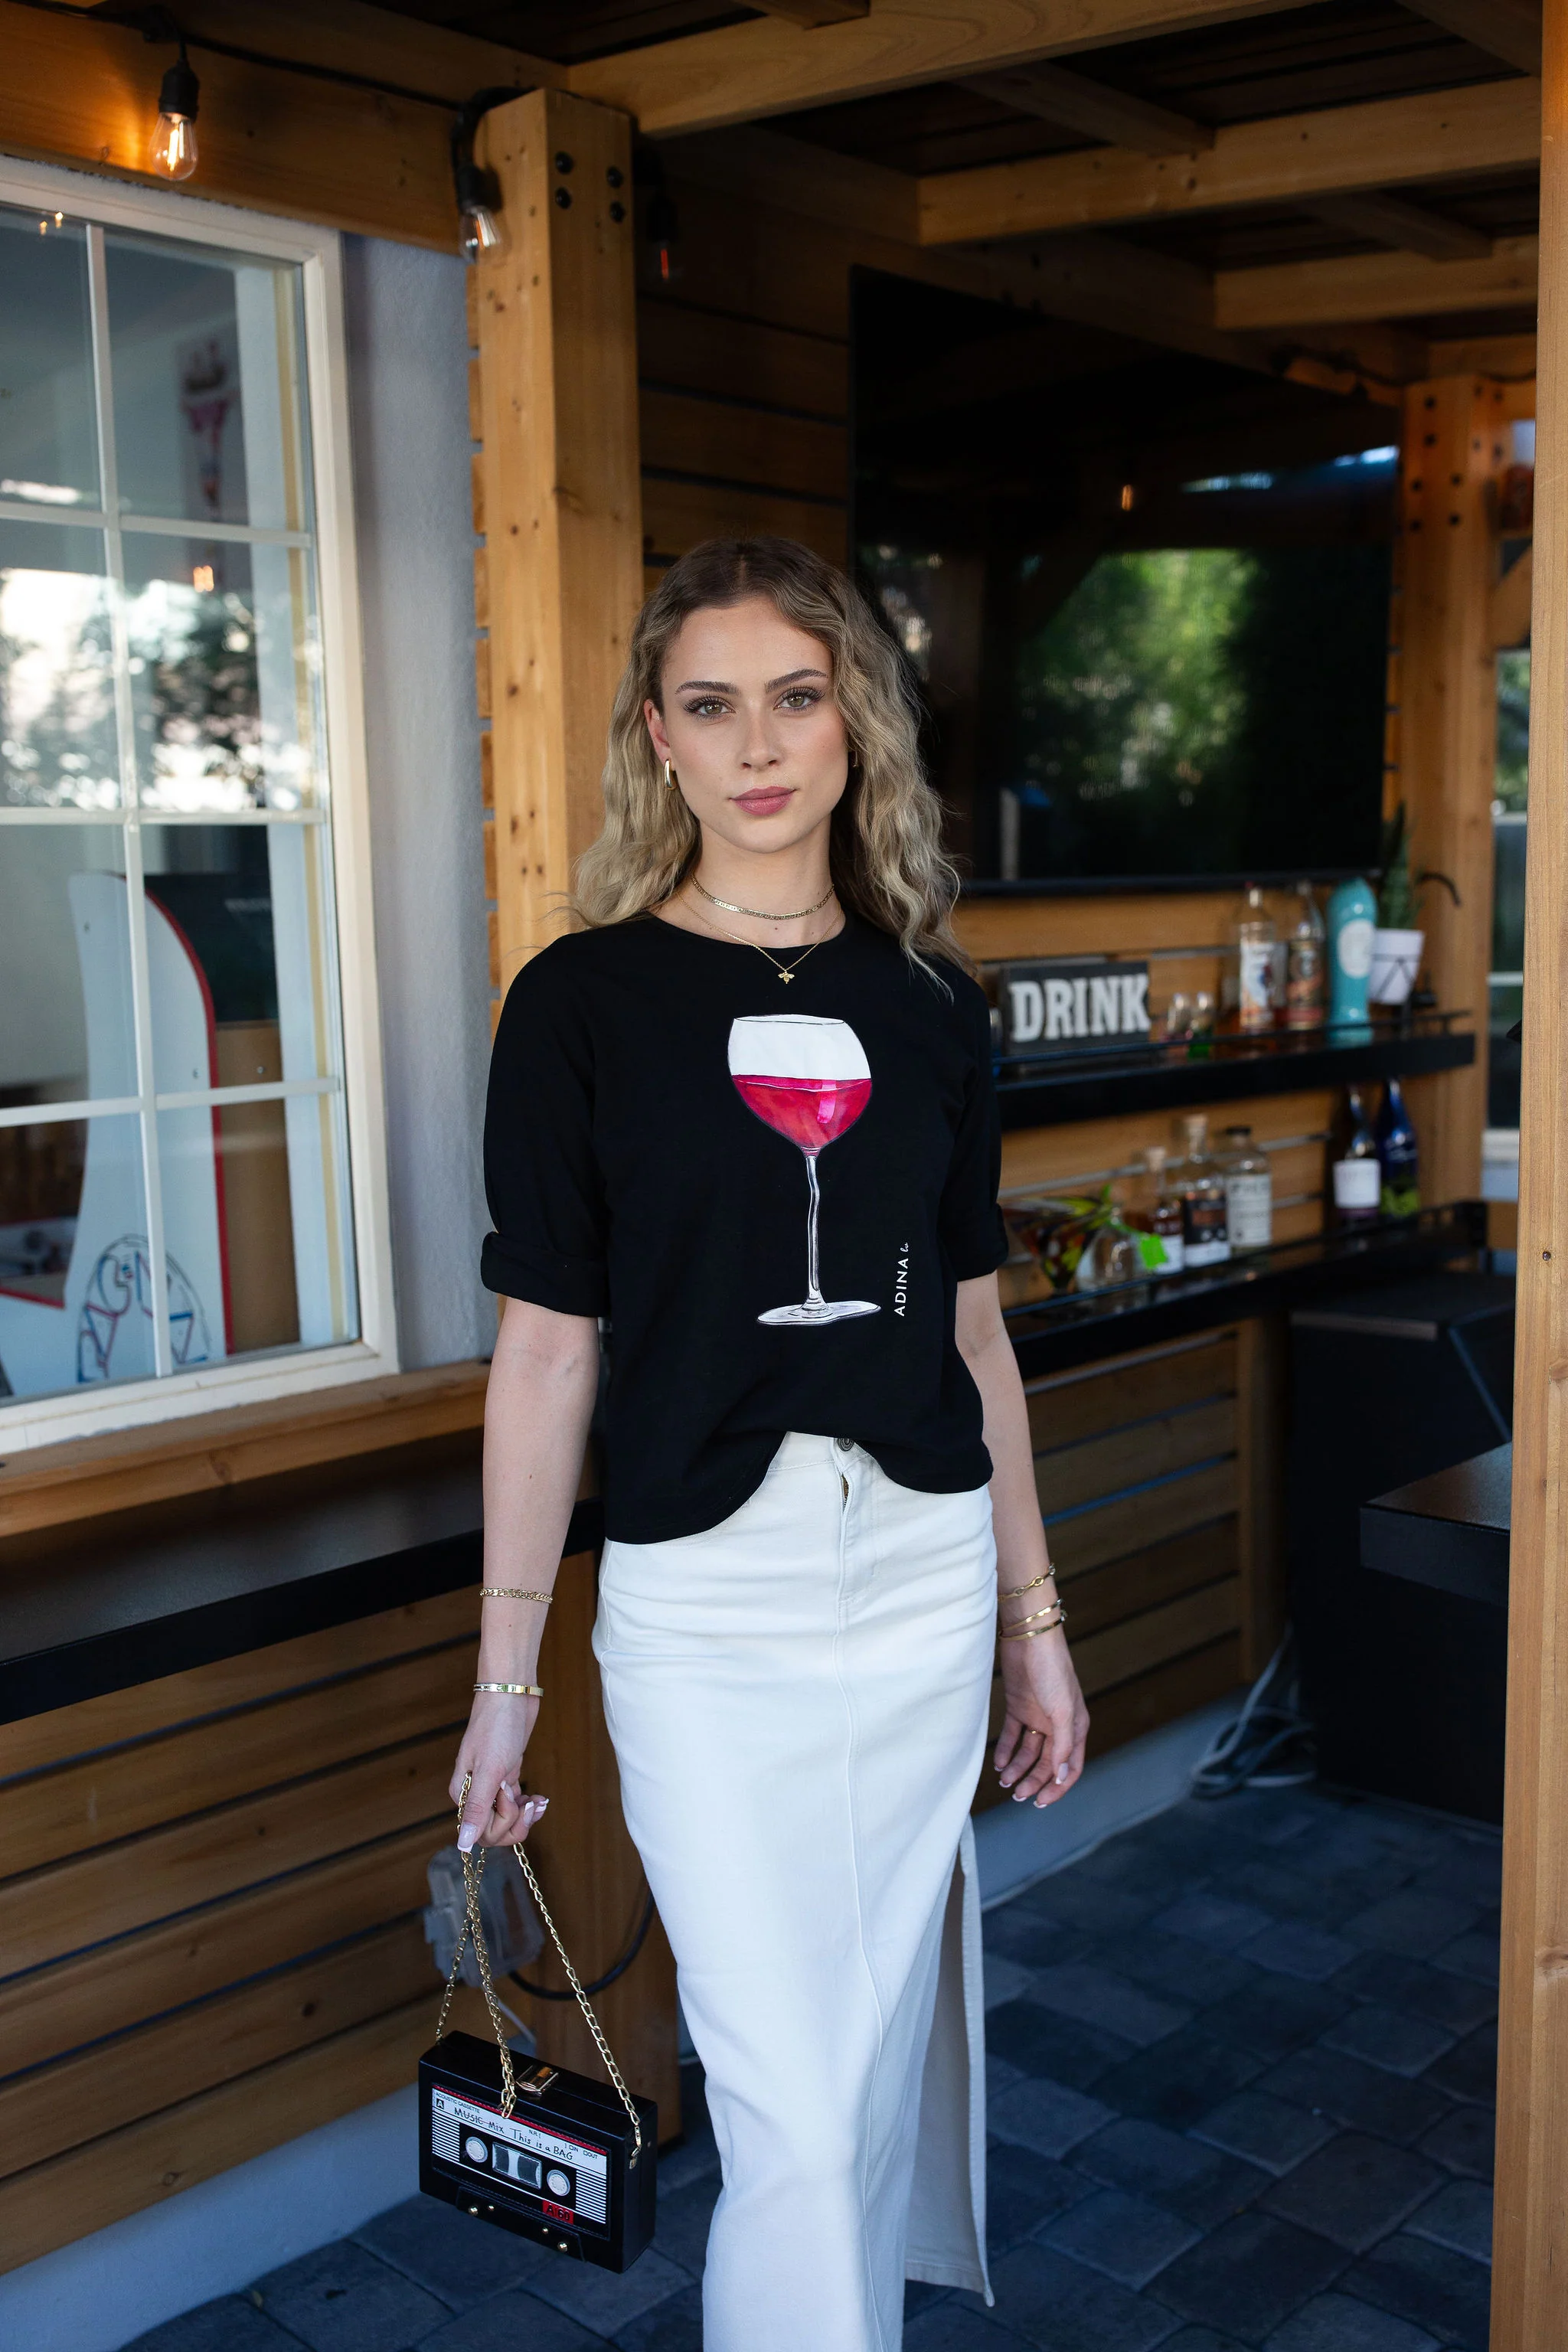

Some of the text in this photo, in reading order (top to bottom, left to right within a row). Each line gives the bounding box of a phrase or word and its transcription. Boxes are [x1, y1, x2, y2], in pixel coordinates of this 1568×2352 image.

[1008, 972, 1151, 1043] DRINK
[893, 1258, 909, 1317] ADINA
[436, 2099, 444, 2109] A
[458, 2100, 480, 2113] CASSETTE
[454, 2107, 483, 2125] MUSIC
[509, 2127, 531, 2145] This
[536, 2140, 542, 2148] is
[554, 2145, 573, 2160] BAG
